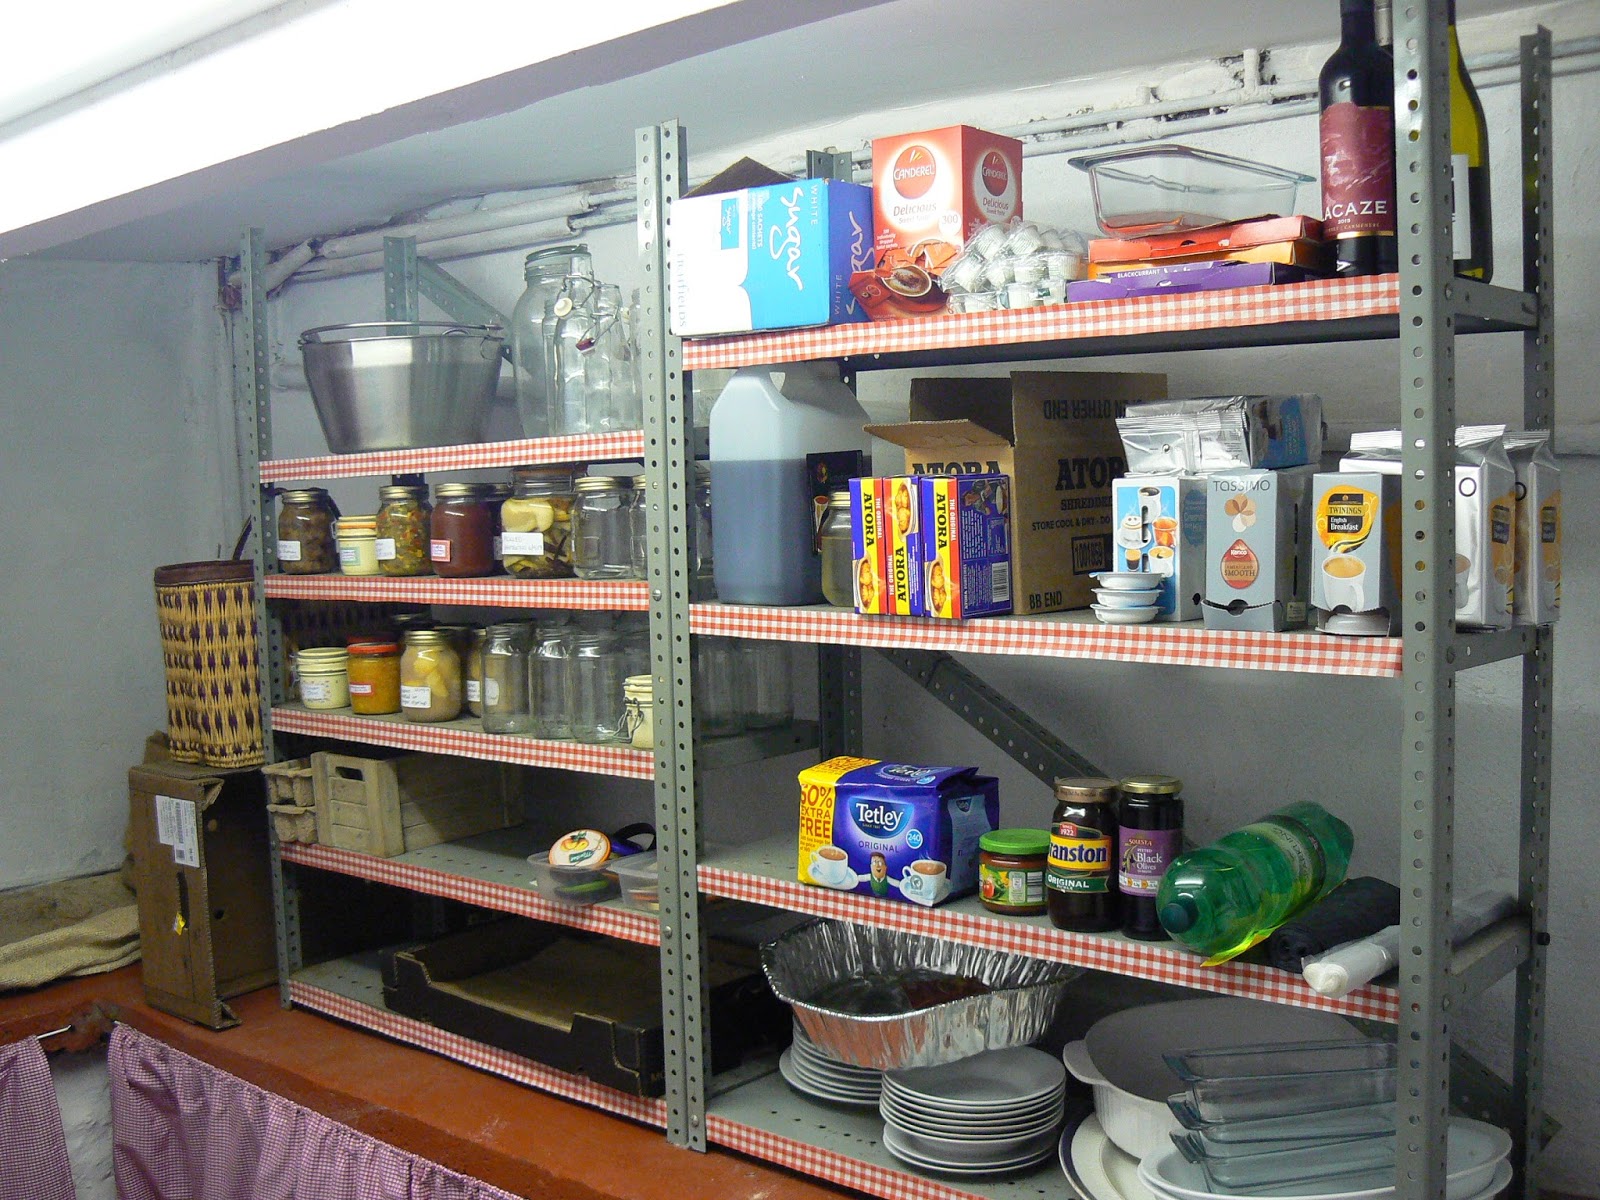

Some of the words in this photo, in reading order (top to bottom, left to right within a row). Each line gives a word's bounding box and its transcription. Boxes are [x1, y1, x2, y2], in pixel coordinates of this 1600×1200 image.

[893, 164, 935, 181] CANDEREL
[811, 185, 819, 225] WHITE
[893, 202, 937, 217] Delicious
[941, 214, 959, 225] 300
[769, 187, 804, 291] sugar
[1117, 268, 1160, 278] BLACKCURRANT
[834, 274, 843, 316] WHITE
[1055, 456, 1124, 491] ATOR
[1329, 506, 1362, 515] TWININGS
[864, 493, 874, 547] ATORA
[936, 493, 947, 549] ATORA
[1032, 520, 1054, 531] STORE
[1055, 518, 1074, 529] COOL
[1081, 516, 1094, 527] DRY
[1330, 523, 1359, 531] Breakfast
[895, 546, 907, 602] ATORA
[1029, 594, 1042, 609] BB
[1044, 590, 1063, 608] END
[801, 805, 831, 819] EXTRA
[856, 803, 904, 831] Tetley
[801, 816, 831, 839] FREE
[908, 833, 920, 841] 240
[859, 840, 900, 853] ORIGINAL
[1049, 843, 1107, 863] ranston
[1137, 852, 1163, 863] Black
[1136, 862, 1157, 870] Olives
[1047, 874, 1090, 888] ORIGINAL
